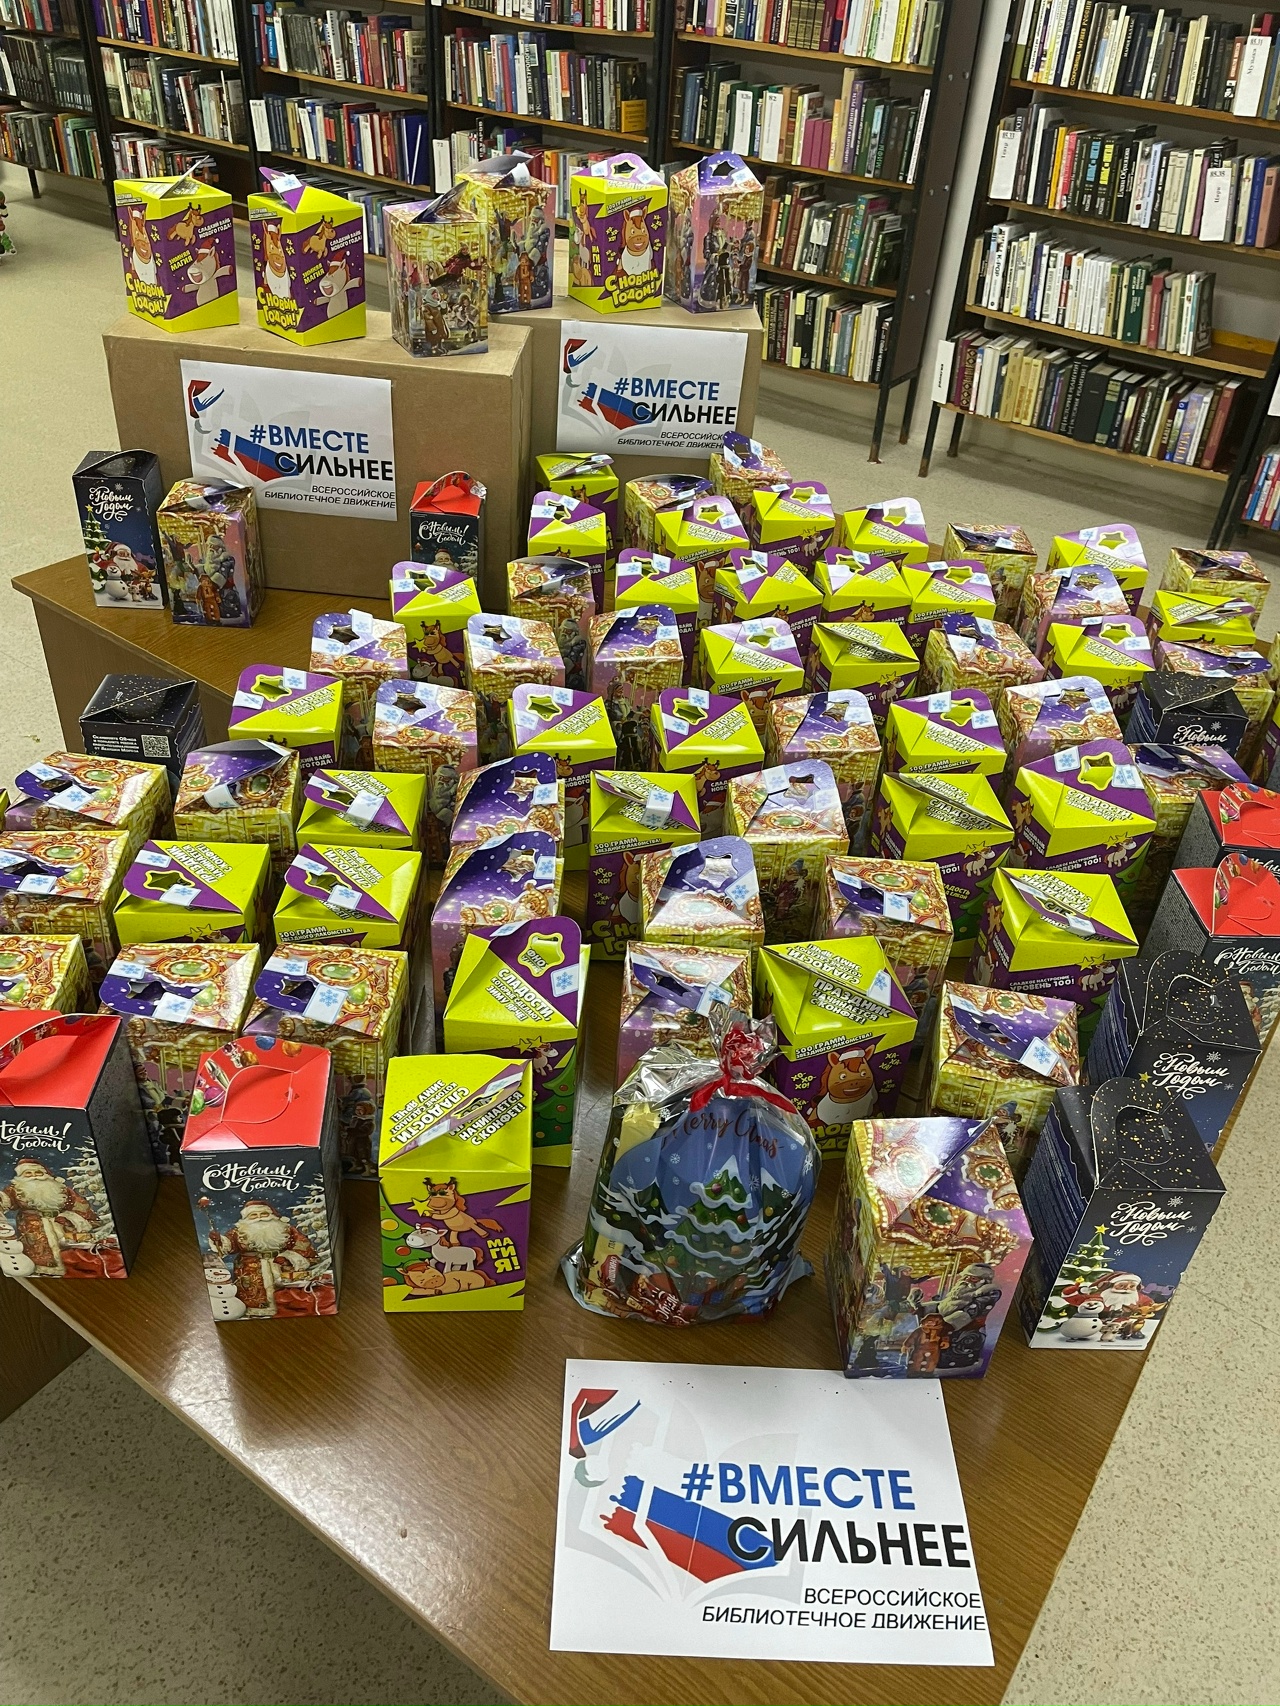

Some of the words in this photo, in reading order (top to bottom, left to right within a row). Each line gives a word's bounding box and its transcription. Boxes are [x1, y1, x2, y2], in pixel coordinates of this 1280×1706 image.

[1081, 0, 1093, 26] РОССИИ
[1077, 27, 1088, 49] МУЗЕЕВ
[1069, 50, 1083, 86] СОКРОВИЩА
[1117, 180, 1127, 198] Елена
[170, 255, 193, 271] МАГИЯ
[126, 273, 134, 290] С
[134, 282, 164, 298] НОВЫМ
[304, 268, 325, 284] МАГИЯ
[605, 274, 616, 290] С
[618, 268, 659, 290] НОВЫМ
[132, 294, 164, 314] ГОДОМ!
[257, 287, 266, 305] С
[267, 295, 298, 311] НОВЫМ
[612, 282, 655, 306] ГОДОМ!
[264, 307, 295, 328] ГОДОМ!
[614, 378, 719, 400] #ВМЕСТЕ
[632, 402, 737, 424] СИЛЬНЕЕ
[250, 424, 369, 454] #ВМЕСТЕ
[617, 439, 685, 448] БИБЛИОТЕЧНОЕ
[661, 432, 723, 441] ВСЕРОССИЙСК
[274, 452, 393, 481] СИЛЬНЕЕ
[265, 491, 341, 505] БИБЛИОТЕЧНОЕ
[342, 498, 396, 509] ДВИЖЕНИЕ
[312, 485, 396, 500] ВСЕРОССИЙСКОЕ
[91, 499, 134, 521] Годом
[928, 724, 988, 751] ПРАЗДНИК
[924, 759, 950, 770] ГРАММ
[929, 800, 992, 830] СЛАДОСТИ,
[1068, 790, 1133, 820] СЛАДОСТИ,
[610, 837, 638, 847] ГРАММ
[166, 845, 218, 883] ПРАЗДНИК
[182, 844, 225, 878] НАЧИНАЕТСЯ
[195, 843, 226, 869] КОНФЕТ!
[1084, 858, 1101, 866] 100!
[324, 848, 371, 888] СЛАДОСТИ,
[364, 862, 384, 879] ЗИМУ
[593, 867, 606, 876] ХО-
[603, 871, 615, 879] ХО-
[942, 865, 960, 875] 100!
[297, 926, 327, 935] ГРАММ
[315, 928, 353, 938] ЛАКОМСТВА!
[786, 946, 860, 985] СЛАДОСТИ,
[835, 956, 862, 969] ЗИМУ
[1010, 983, 1051, 991] УРОВЕНЬ
[1054, 979, 1074, 987] 100!
[1037, 975, 1069, 983] НАСТРОЕНИЕ
[486, 985, 510, 1004] ЗИМУ
[505, 1002, 528, 1021] ЯРЧЕ!
[491, 977, 517, 999] КОТОРЫЕ
[514, 997, 542, 1021] СДЕЛАЮТ
[498, 969, 554, 1021] СЛАДОСТИ,
[812, 990, 879, 1022] НАЧИНАЕТСЯ
[813, 978, 892, 1018] ПРАЗДНИК
[819, 1001, 867, 1025] КОНФЕТ!
[795, 1046, 813, 1055] 500
[814, 1035, 846, 1050] ГРАММ
[796, 1045, 831, 1059] ЗВЕЗДНОГО
[833, 1033, 873, 1048] ЛАКОМСТВА!
[791, 1072, 807, 1081] ХО-
[1159, 1052, 1230, 1078] Новым
[802, 1075, 816, 1083] ХО-
[1152, 1070, 1223, 1100] Годом
[417, 1080, 446, 1103] ЗИМУ
[424, 1082, 458, 1107] КОТОРЫЕ
[390, 1100, 418, 1123] ЯРЧЕ!
[390, 1087, 470, 1144] СЛАДОСТИ,
[390, 1105, 426, 1135] СДЕЛАЮТ
[459, 1091, 524, 1141] НАЧИНАЕТСЯ
[471, 1136, 482, 1145] С
[479, 1102, 527, 1140] КОНФЕТ!
[8, 1135, 71, 1153] Годом
[236, 1176, 300, 1193] Годом
[1116, 1201, 1193, 1224] Новым
[487, 1236, 513, 1249] МА
[1109, 1219, 1186, 1247] Годом
[490, 1245, 517, 1259] ГИ
[494, 1258, 521, 1274] Я!
[681, 1463, 915, 1511] #ВМЕСТЕ
[727, 1516, 971, 1568] СИЛЬНЕЕ
[804, 1588, 981, 1609] ВСЕРОССИЙСКОЕ
[702, 1606, 866, 1629] БИБЛИОТЕЧНОЕ
[871, 1611, 987, 1632] ДВИЖЕНИЕ
